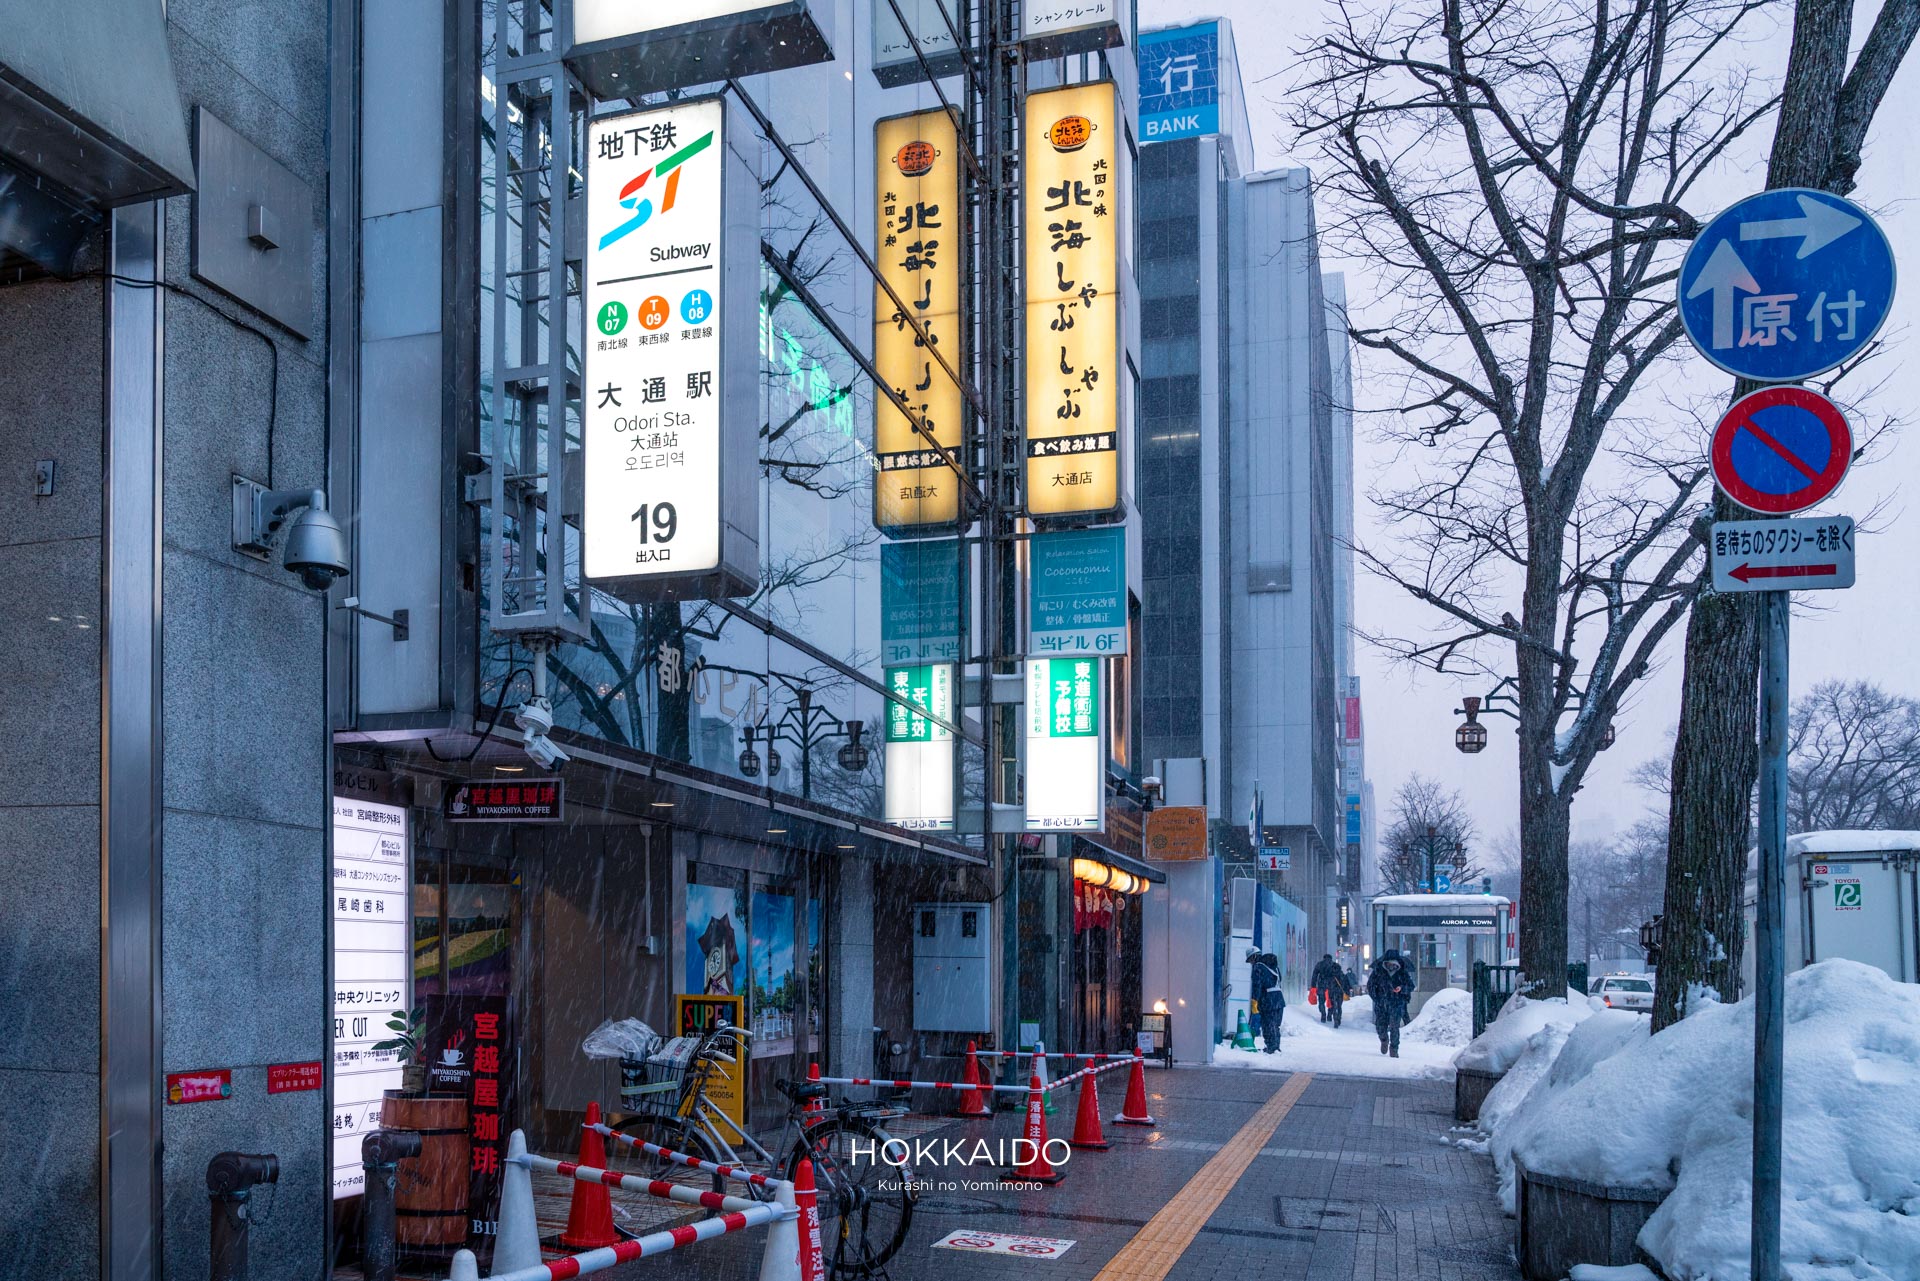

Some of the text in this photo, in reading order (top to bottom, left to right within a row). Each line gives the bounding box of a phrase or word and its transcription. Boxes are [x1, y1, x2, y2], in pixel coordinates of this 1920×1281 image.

[1033, 4, 1106, 25] シャンクレール
[1160, 54, 1198, 94] 行
[1146, 114, 1200, 136] BANK
[598, 121, 677, 160] 地下鉄
[650, 242, 711, 262] Subway
[649, 299, 659, 311] T
[691, 293, 701, 305] H
[1044, 180, 1099, 420] 北海しゃぶしゃぶ
[607, 306, 618, 317] N
[646, 313, 662, 326] 09
[688, 307, 704, 320] 08
[1738, 289, 1866, 348] 原付
[604, 318, 620, 331] 07
[638, 332, 670, 346] 東西線
[681, 326, 713, 341] 東豊線
[597, 337, 628, 351] 南北線
[597, 370, 712, 409] 大通駅
[614, 411, 695, 432] Odori Sta.
[630, 431, 679, 452] 大通站
[1033, 435, 1110, 456] 食べ飲み放題
[624, 450, 684, 471] 오도리역
[1051, 472, 1093, 487] 大通店
[631, 501, 677, 544] 19
[1715, 525, 1852, 556] 客待ちのタクシーを除く
[635, 549, 671, 563] 出入口
[1044, 565, 1111, 577] Cocomomu
[1039, 633, 1120, 651] 当ビル 6F
[658, 640, 768, 727] 都心ビル
[1073, 661, 1092, 733] 東進衛星
[1054, 680, 1072, 733] 予備校
[476, 806, 551, 814] MIYAKOSHIYA COFFEE
[1042, 817, 1083, 827] 都心ビル
[381, 840, 401, 850] 都心ビル
[1270, 856, 1277, 869] 1
[334, 868, 347, 879] 眼科
[335, 990, 400, 1005] 中央クリニック
[352, 1017, 368, 1038] CUT
[432, 1068, 470, 1077] MIYAKOSHIYA
[440, 1075, 461, 1083] COFFEE
[473, 1011, 500, 1175] 宮越屋珈琲
